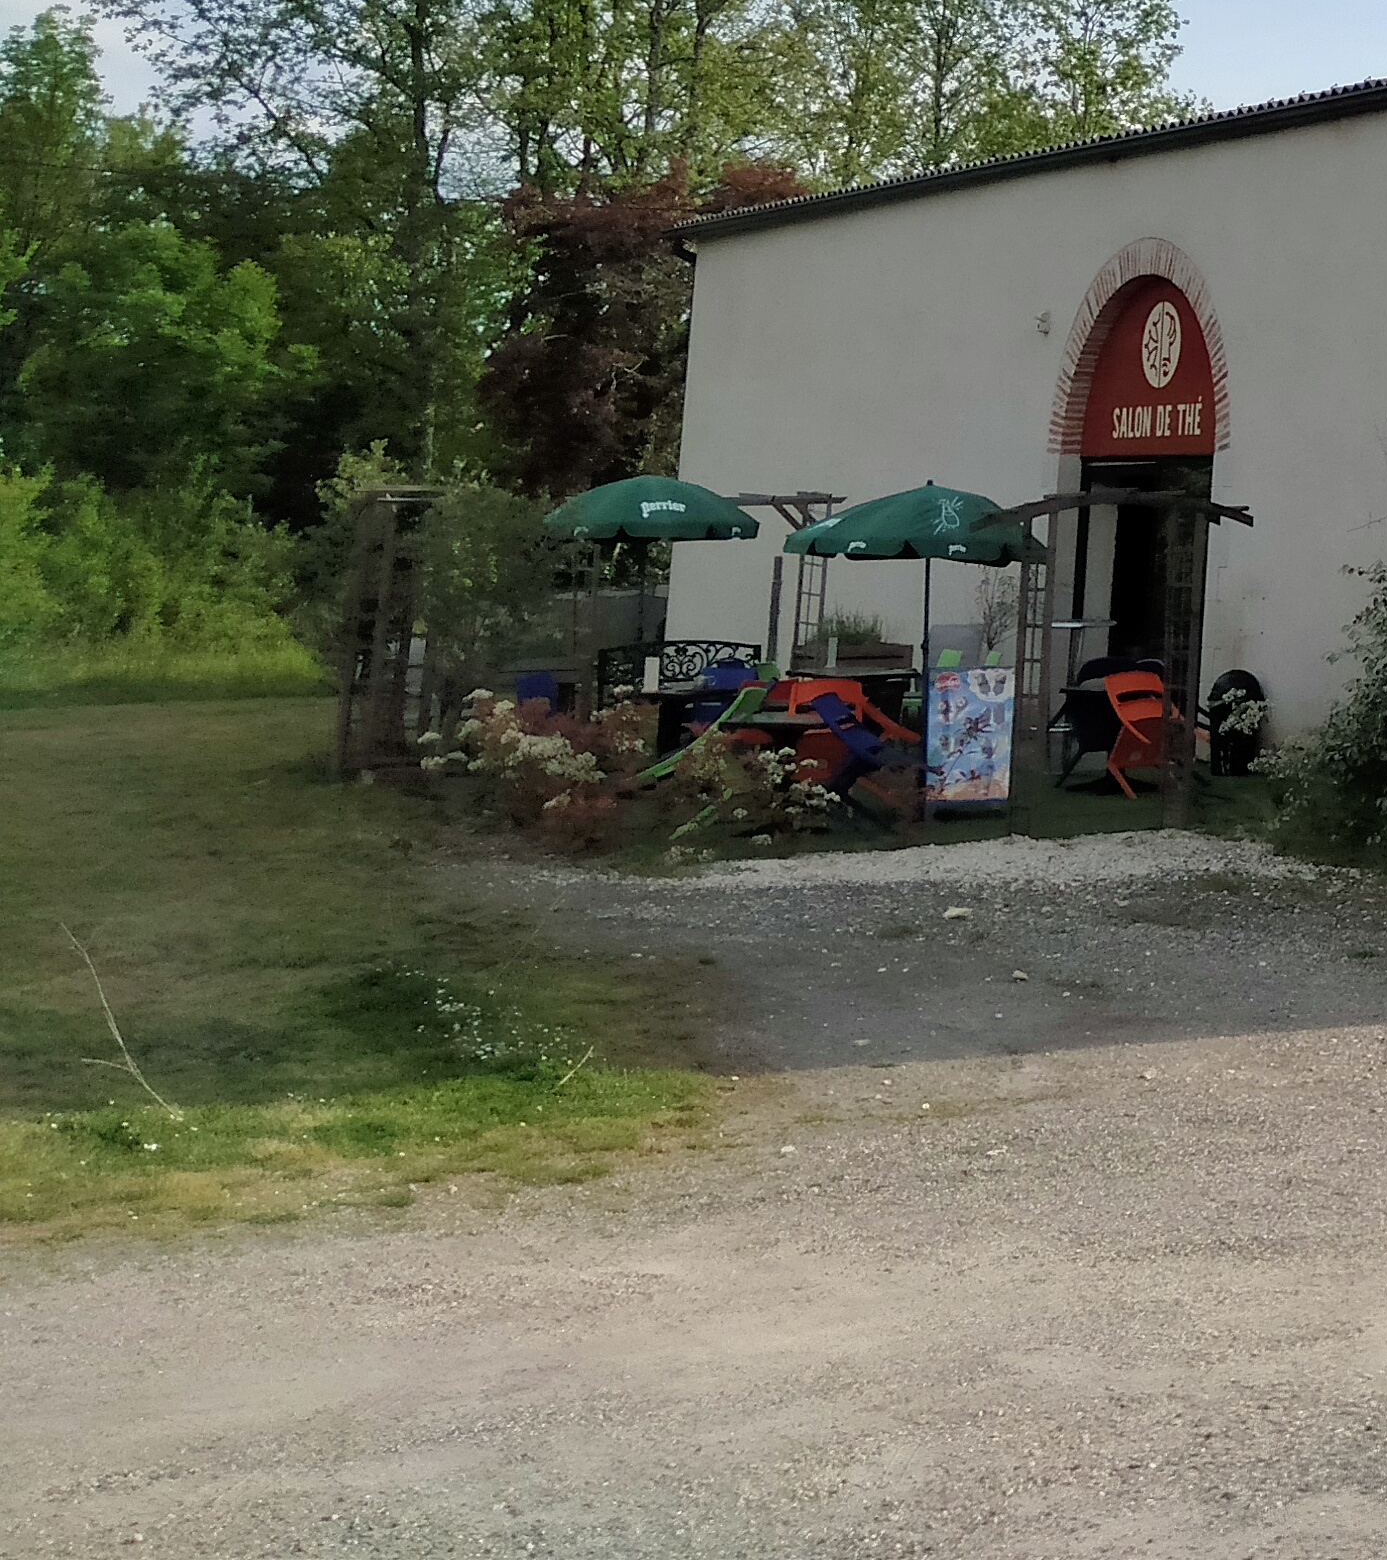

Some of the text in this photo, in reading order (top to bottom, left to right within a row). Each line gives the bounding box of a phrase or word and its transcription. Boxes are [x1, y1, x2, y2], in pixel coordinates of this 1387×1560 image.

[1112, 395, 1203, 439] SALON DE THÉ
